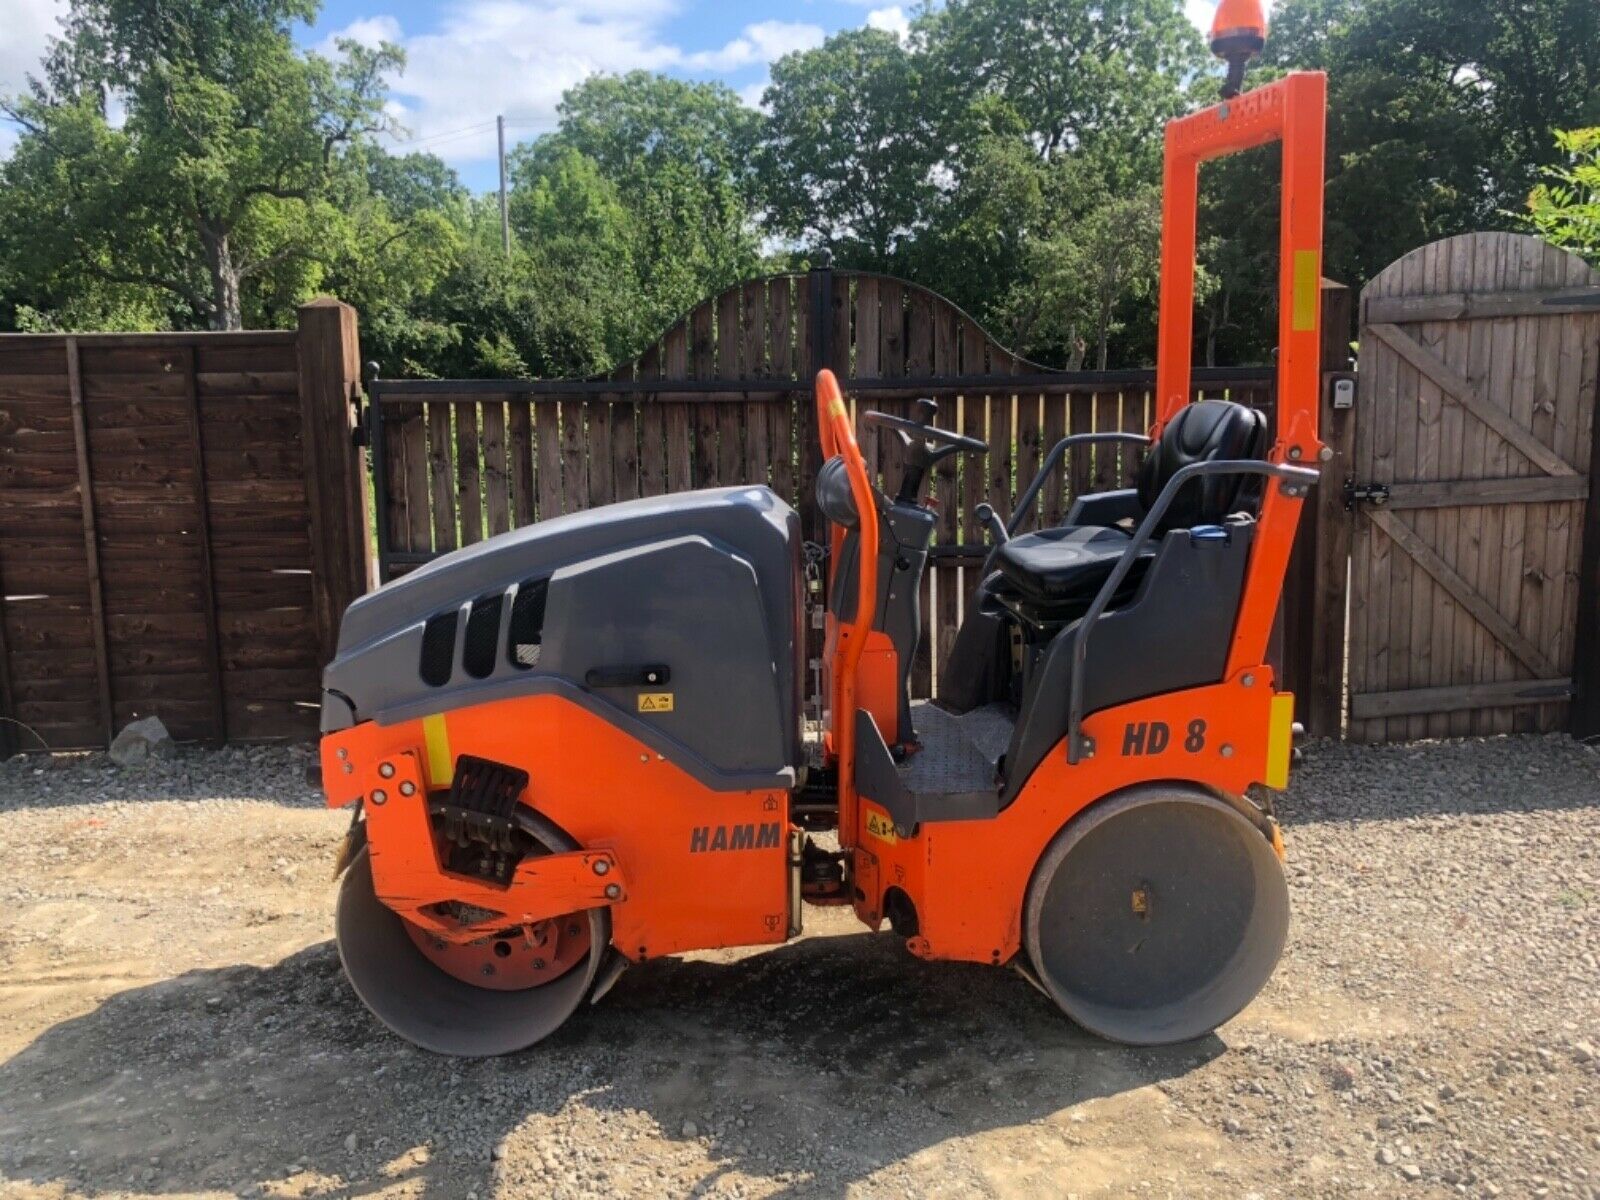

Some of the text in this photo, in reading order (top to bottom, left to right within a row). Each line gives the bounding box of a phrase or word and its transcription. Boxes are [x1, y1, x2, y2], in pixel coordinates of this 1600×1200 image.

[1122, 718, 1207, 756] HD 8
[690, 822, 780, 853] HAMM
